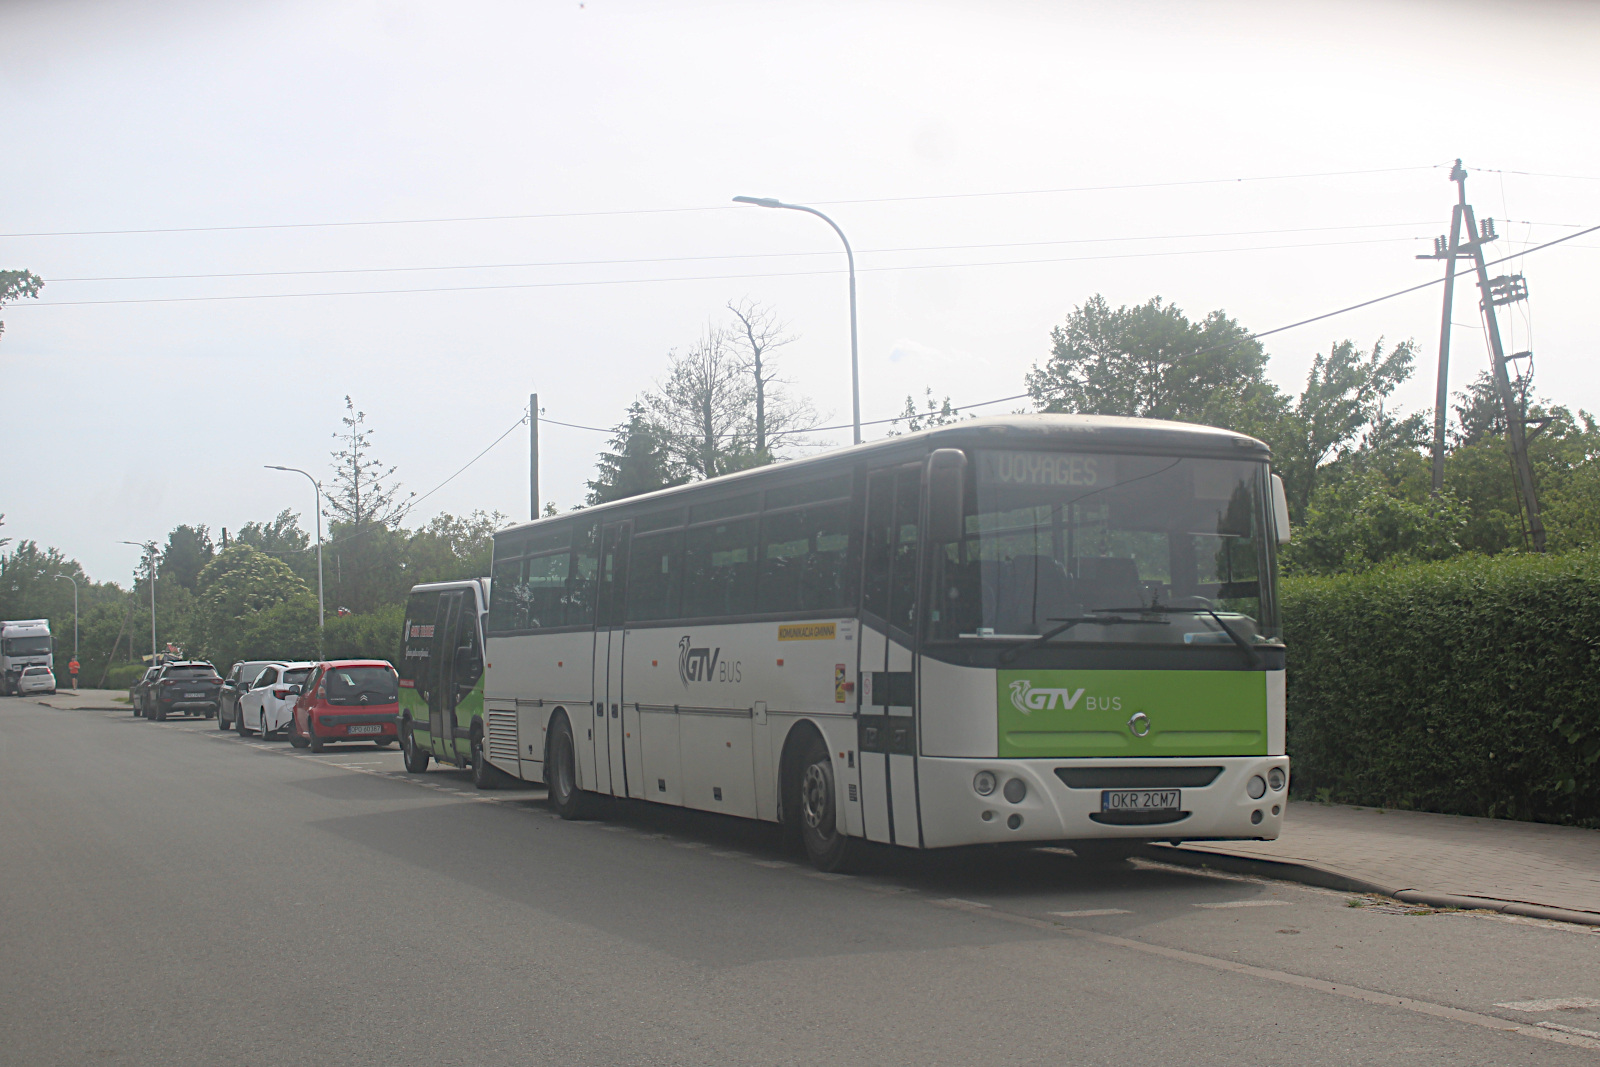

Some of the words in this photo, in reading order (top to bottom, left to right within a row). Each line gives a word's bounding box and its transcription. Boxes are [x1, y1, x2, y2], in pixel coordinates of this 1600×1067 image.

[998, 453, 1098, 486] VOYAGES
[779, 627, 813, 639] KOMUNIKACJA
[815, 625, 834, 637] GMINNA
[686, 647, 720, 682] GTV
[720, 661, 742, 683] BUS
[1024, 688, 1086, 710] GTV
[1086, 696, 1122, 711] BUS
[1112, 793, 1138, 808] OKR
[1143, 792, 1176, 807] 2CM7
